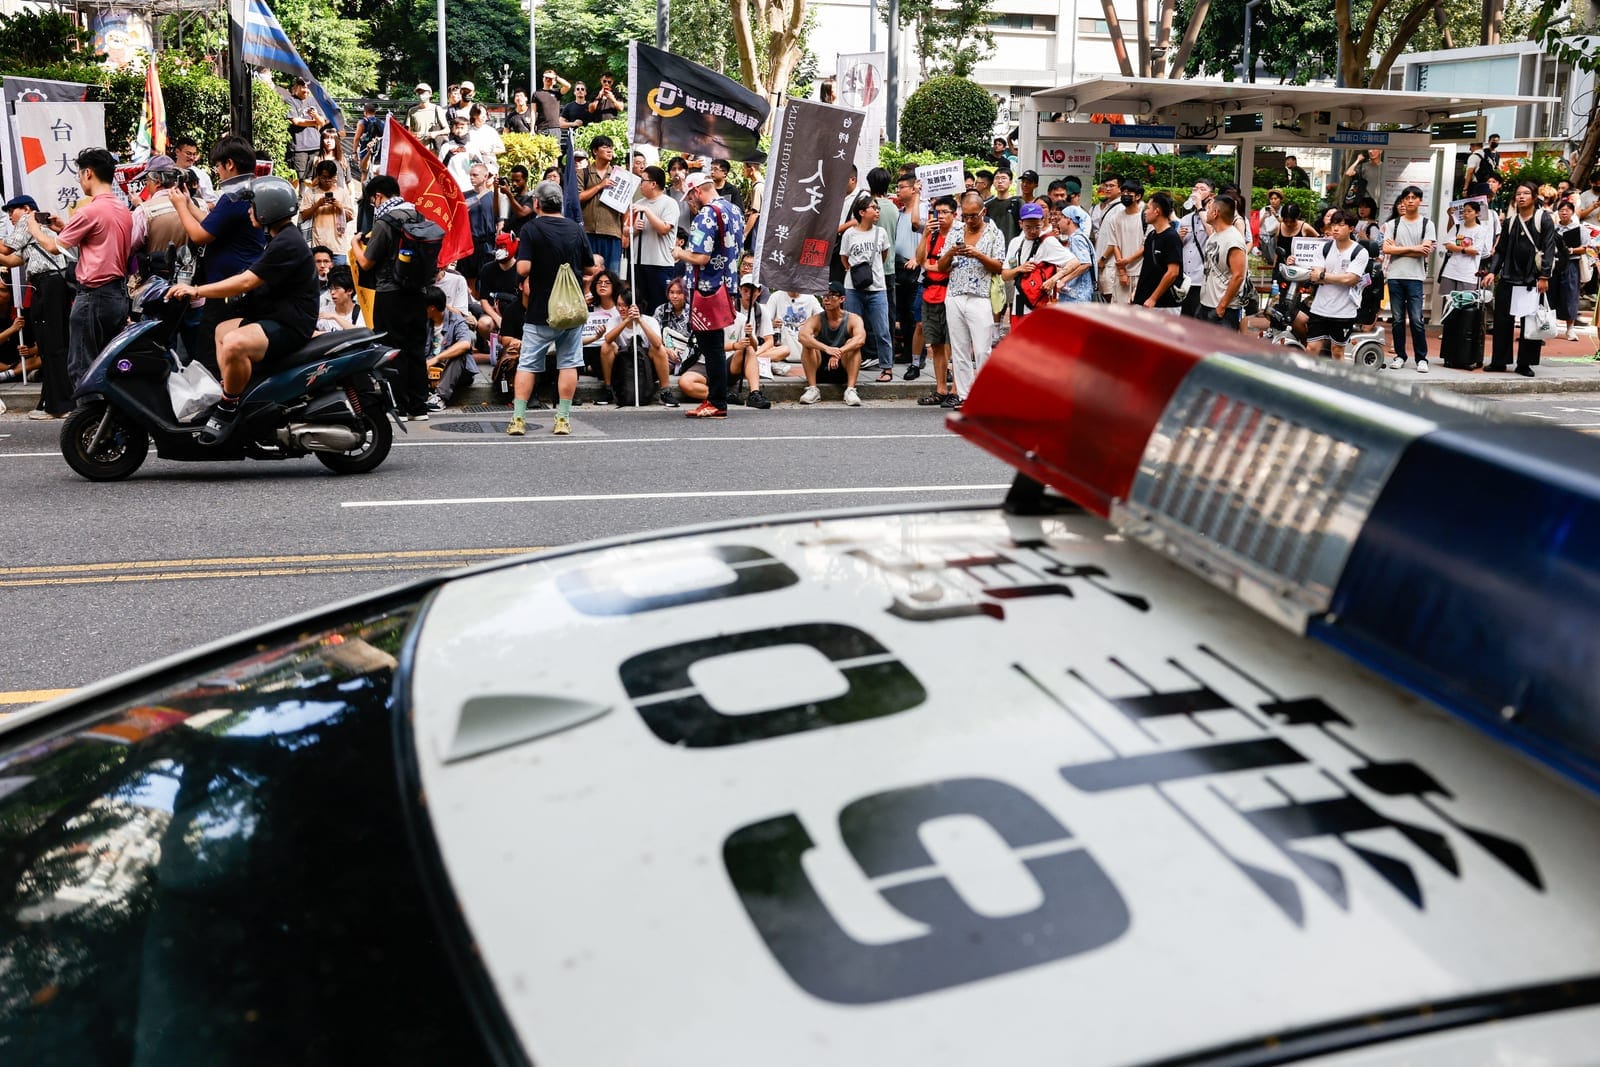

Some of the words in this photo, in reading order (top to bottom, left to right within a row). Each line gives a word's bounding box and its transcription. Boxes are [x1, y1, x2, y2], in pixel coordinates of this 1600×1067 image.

[51, 118, 80, 210] 台大勞
[1042, 149, 1066, 163] NO
[552, 542, 1132, 1002] 009
